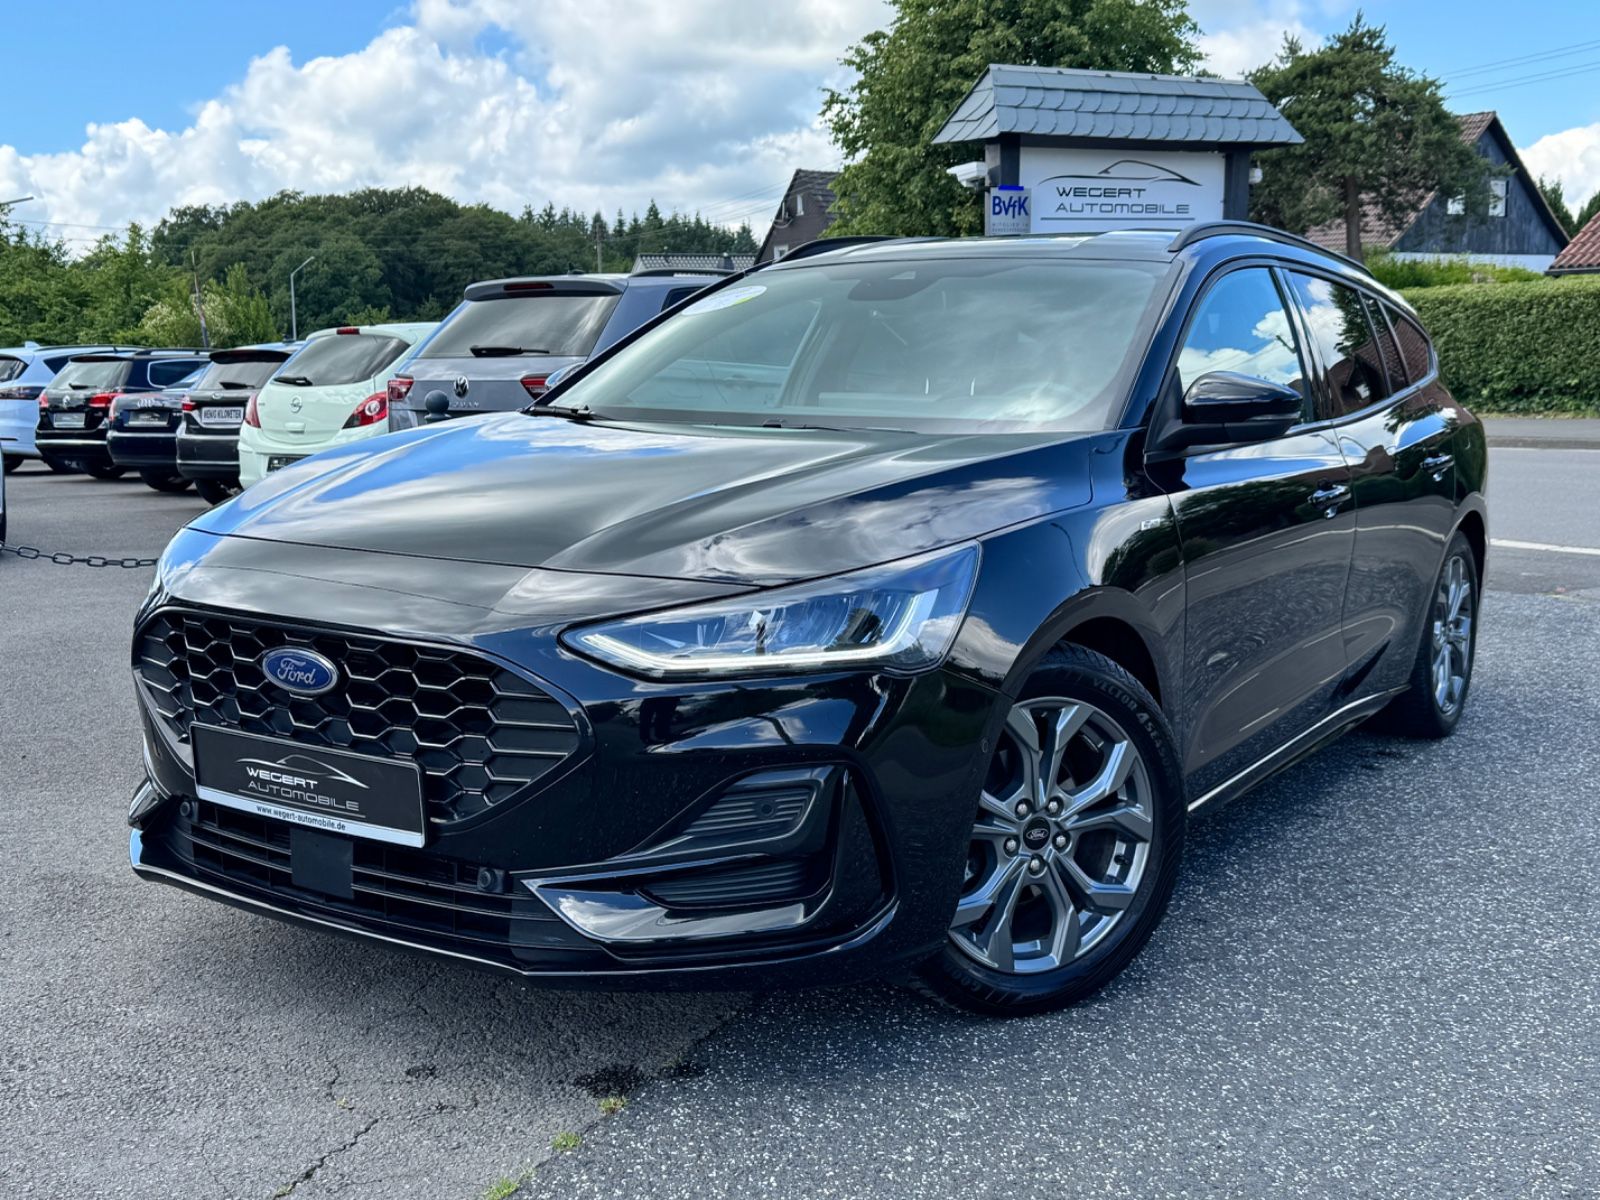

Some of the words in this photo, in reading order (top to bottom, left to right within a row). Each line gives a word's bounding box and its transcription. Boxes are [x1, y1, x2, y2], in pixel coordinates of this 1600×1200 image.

[1056, 187, 1146, 198] WEGERT
[1055, 202, 1190, 215] AUTOMOBILE
[277, 657, 316, 685] Ford
[1092, 678, 1138, 713] VECTOR
[247, 767, 318, 789] WEGERT
[248, 781, 360, 811] AUTOMOBILE
[256, 805, 346, 831] www.wegert-automobile.de
